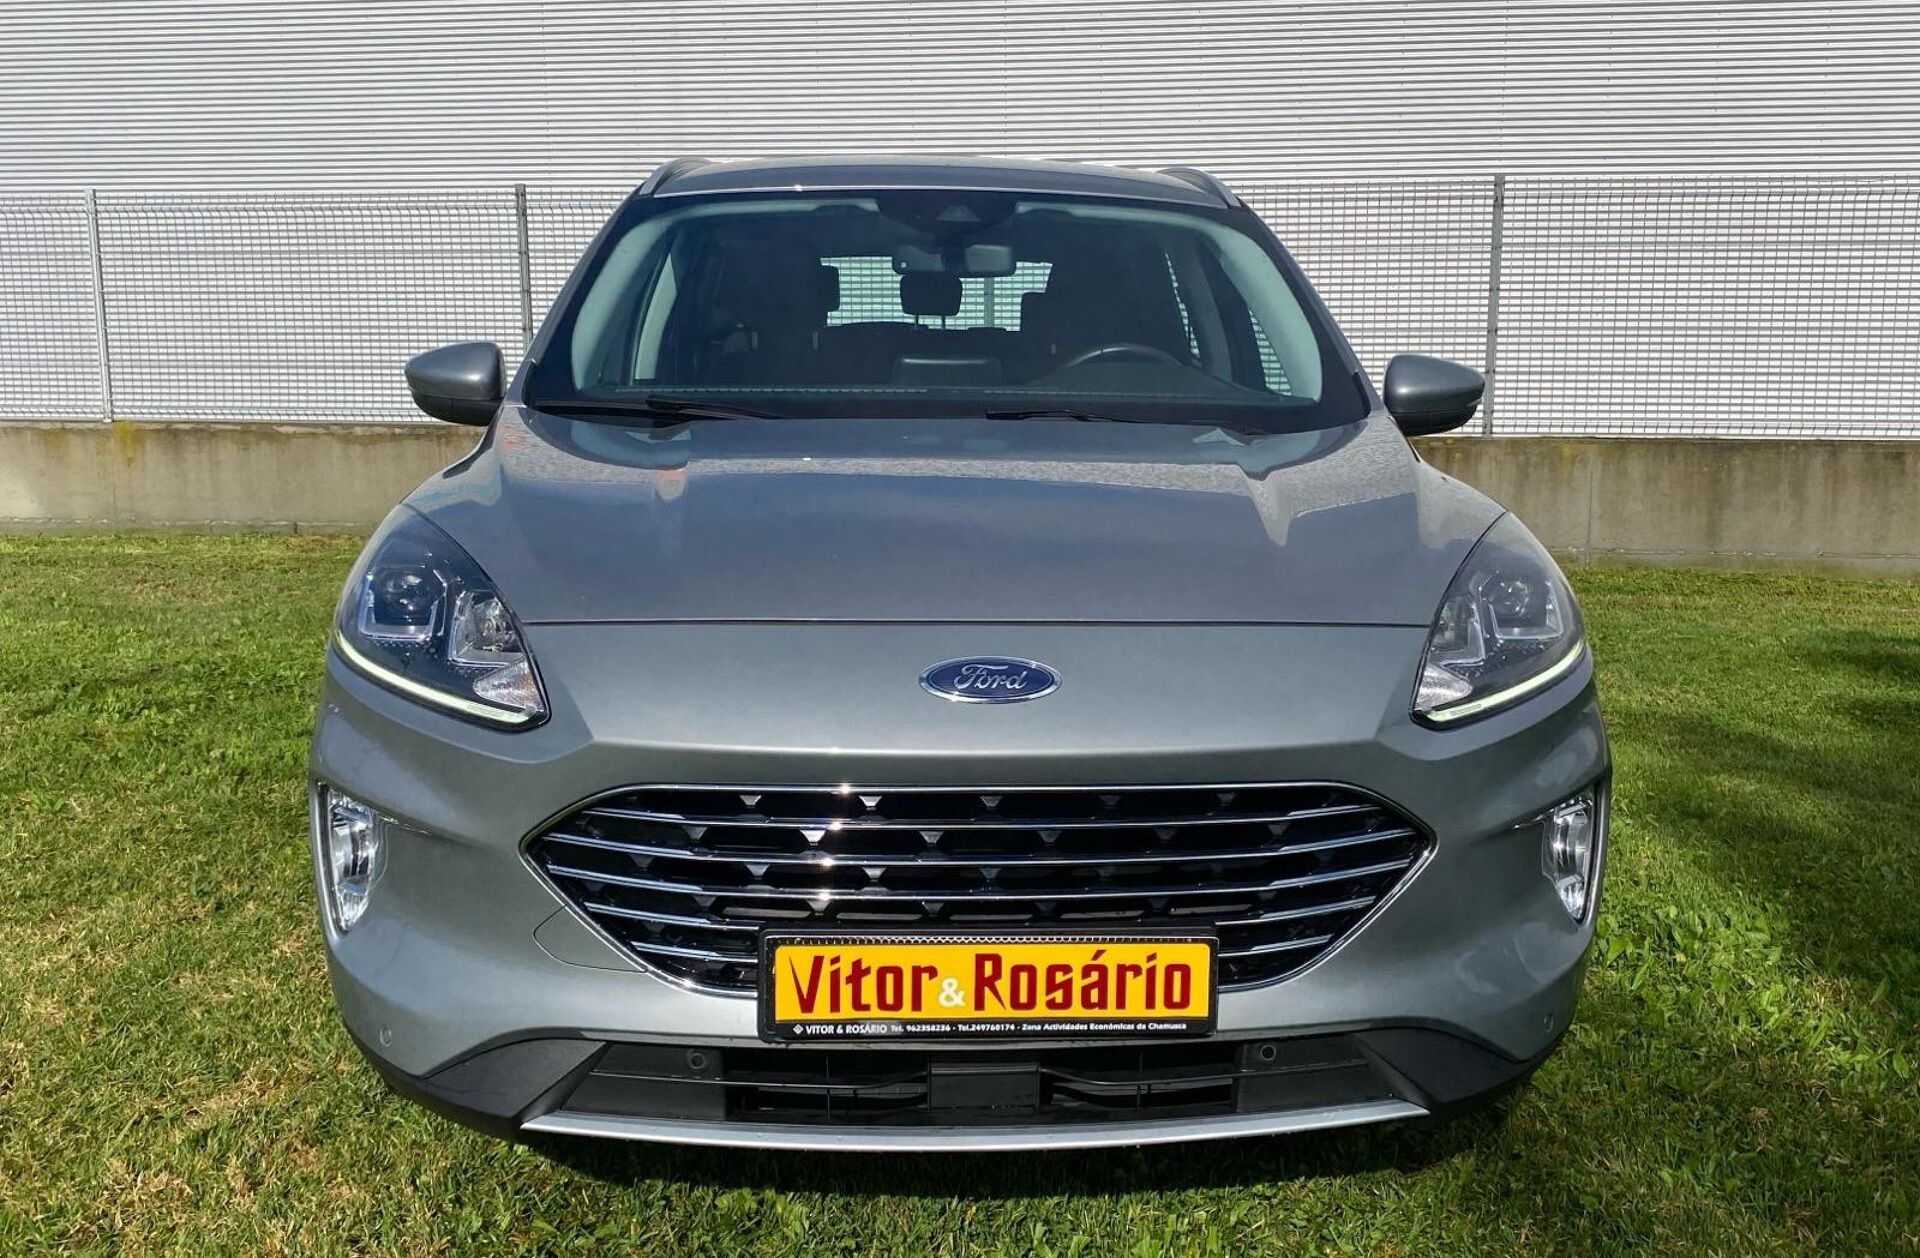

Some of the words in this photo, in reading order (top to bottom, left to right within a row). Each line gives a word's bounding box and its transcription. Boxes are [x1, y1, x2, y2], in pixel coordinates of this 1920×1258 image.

[953, 663, 1028, 689] Ford
[788, 955, 938, 1014] Vitor
[938, 977, 966, 1008] &
[974, 949, 1191, 1011] Rosário
[805, 1024, 834, 1035] VITOR
[836, 1024, 843, 1034] &
[845, 1022, 888, 1035] ROSÁRIO
[1021, 1023, 1041, 1031] Zona
[1043, 1022, 1088, 1031] Actividades
[1136, 1022, 1147, 1030] da
[1147, 1022, 1187, 1030] Chamusca
